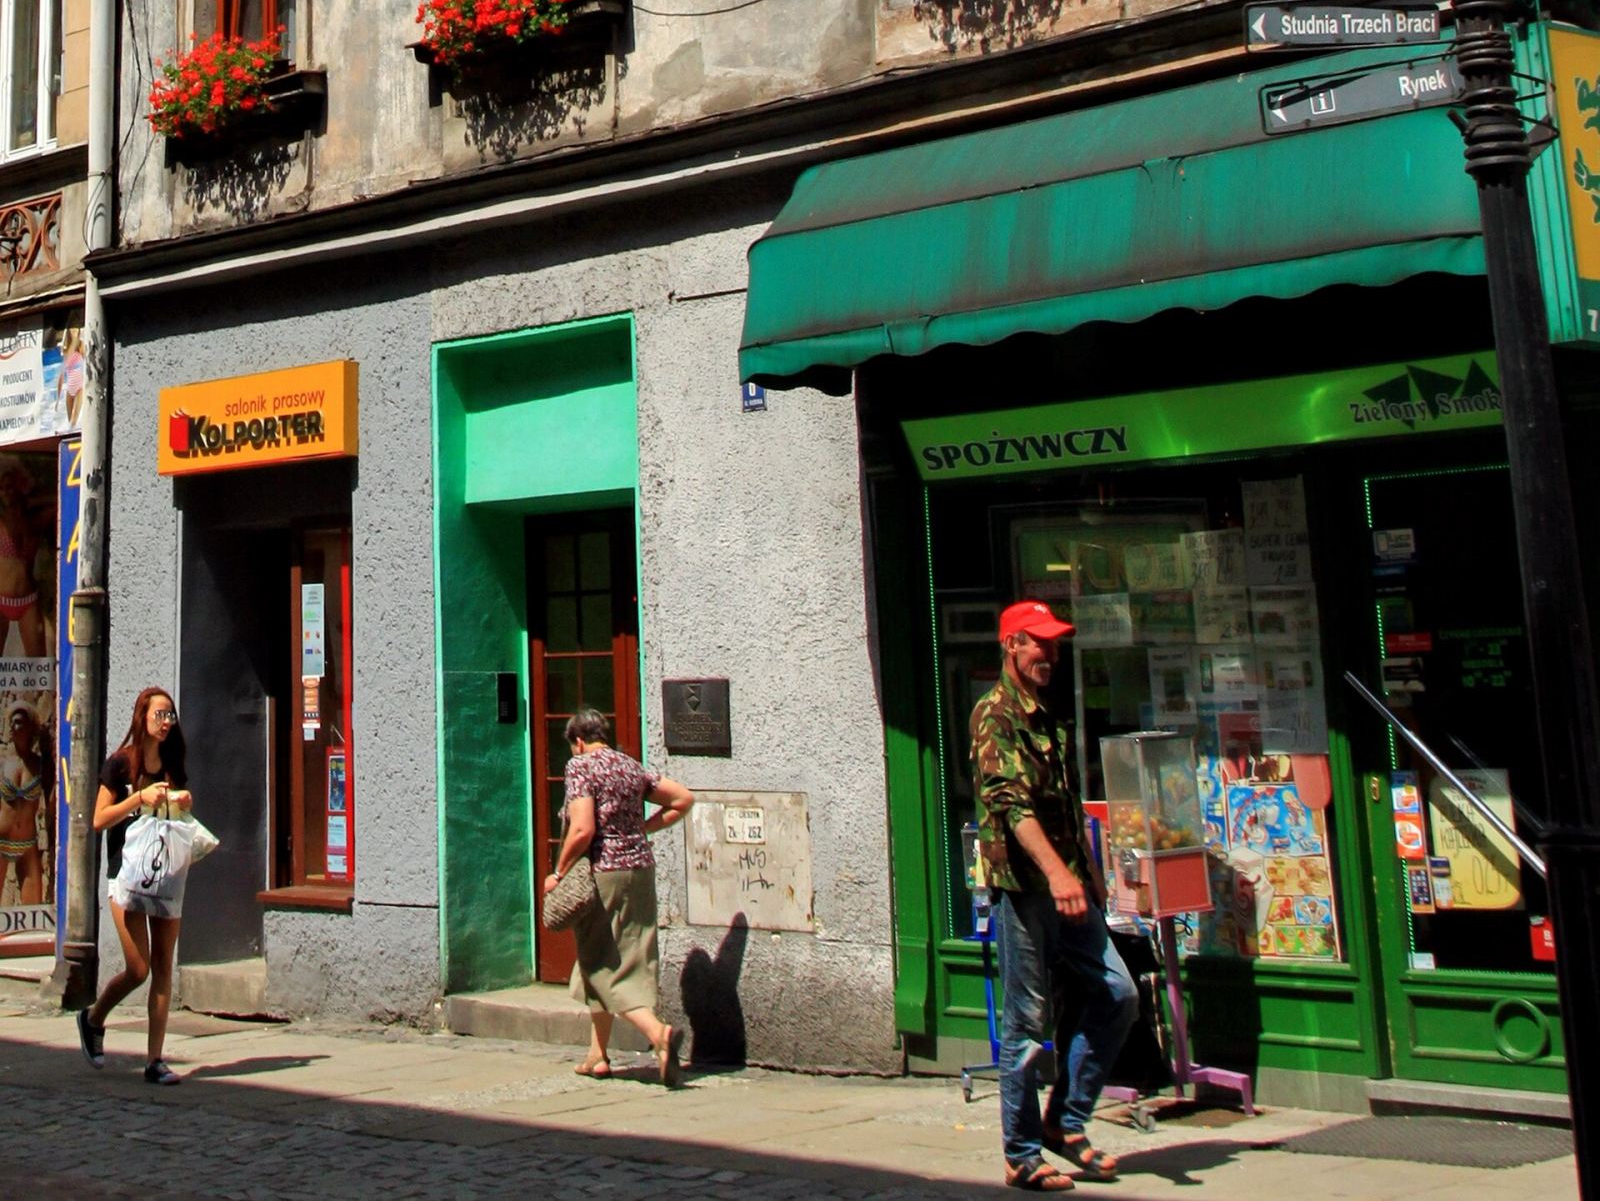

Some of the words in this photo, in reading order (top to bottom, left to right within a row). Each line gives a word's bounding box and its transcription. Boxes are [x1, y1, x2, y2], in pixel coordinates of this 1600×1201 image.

[1281, 14, 1338, 35] Studnia
[1341, 13, 1391, 34] Trzech
[1396, 13, 1435, 33] Braci
[1399, 69, 1447, 99] Rynek
[2, 369, 33, 386] PRODUCENT
[225, 394, 267, 417] salonik
[273, 390, 325, 414] prasowy
[1350, 399, 1428, 423] Zielony
[1434, 388, 1503, 415] Smok
[188, 410, 324, 450] KOLPORTER
[921, 426, 1129, 471] SPOŻYWCZY
[9, 677, 17, 687] A
[23, 676, 36, 687] do
[39, 676, 48, 687] G
